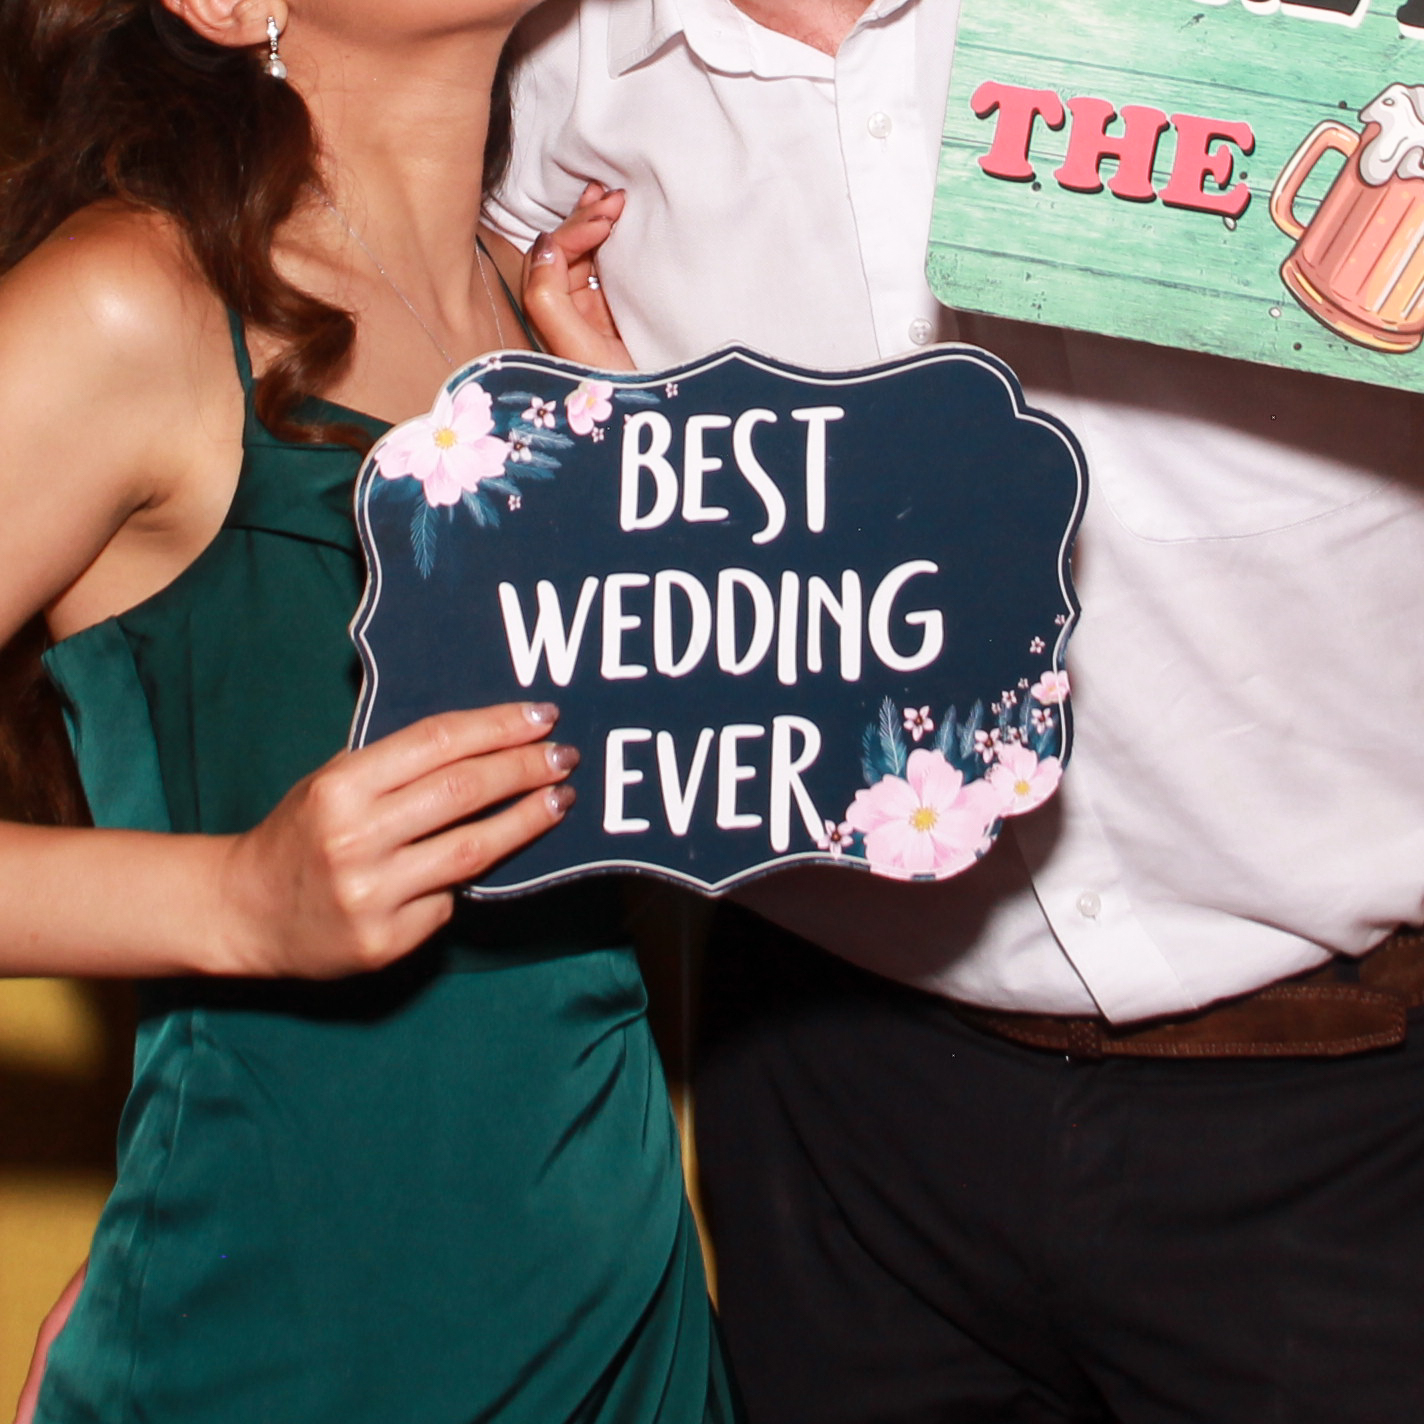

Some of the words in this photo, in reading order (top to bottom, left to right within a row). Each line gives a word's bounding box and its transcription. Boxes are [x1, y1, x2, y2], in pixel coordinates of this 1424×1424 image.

[970, 80, 1256, 219] THE
[619, 406, 844, 544] BEST
[498, 560, 945, 687] WEDDING
[603, 715, 826, 852] EVER
